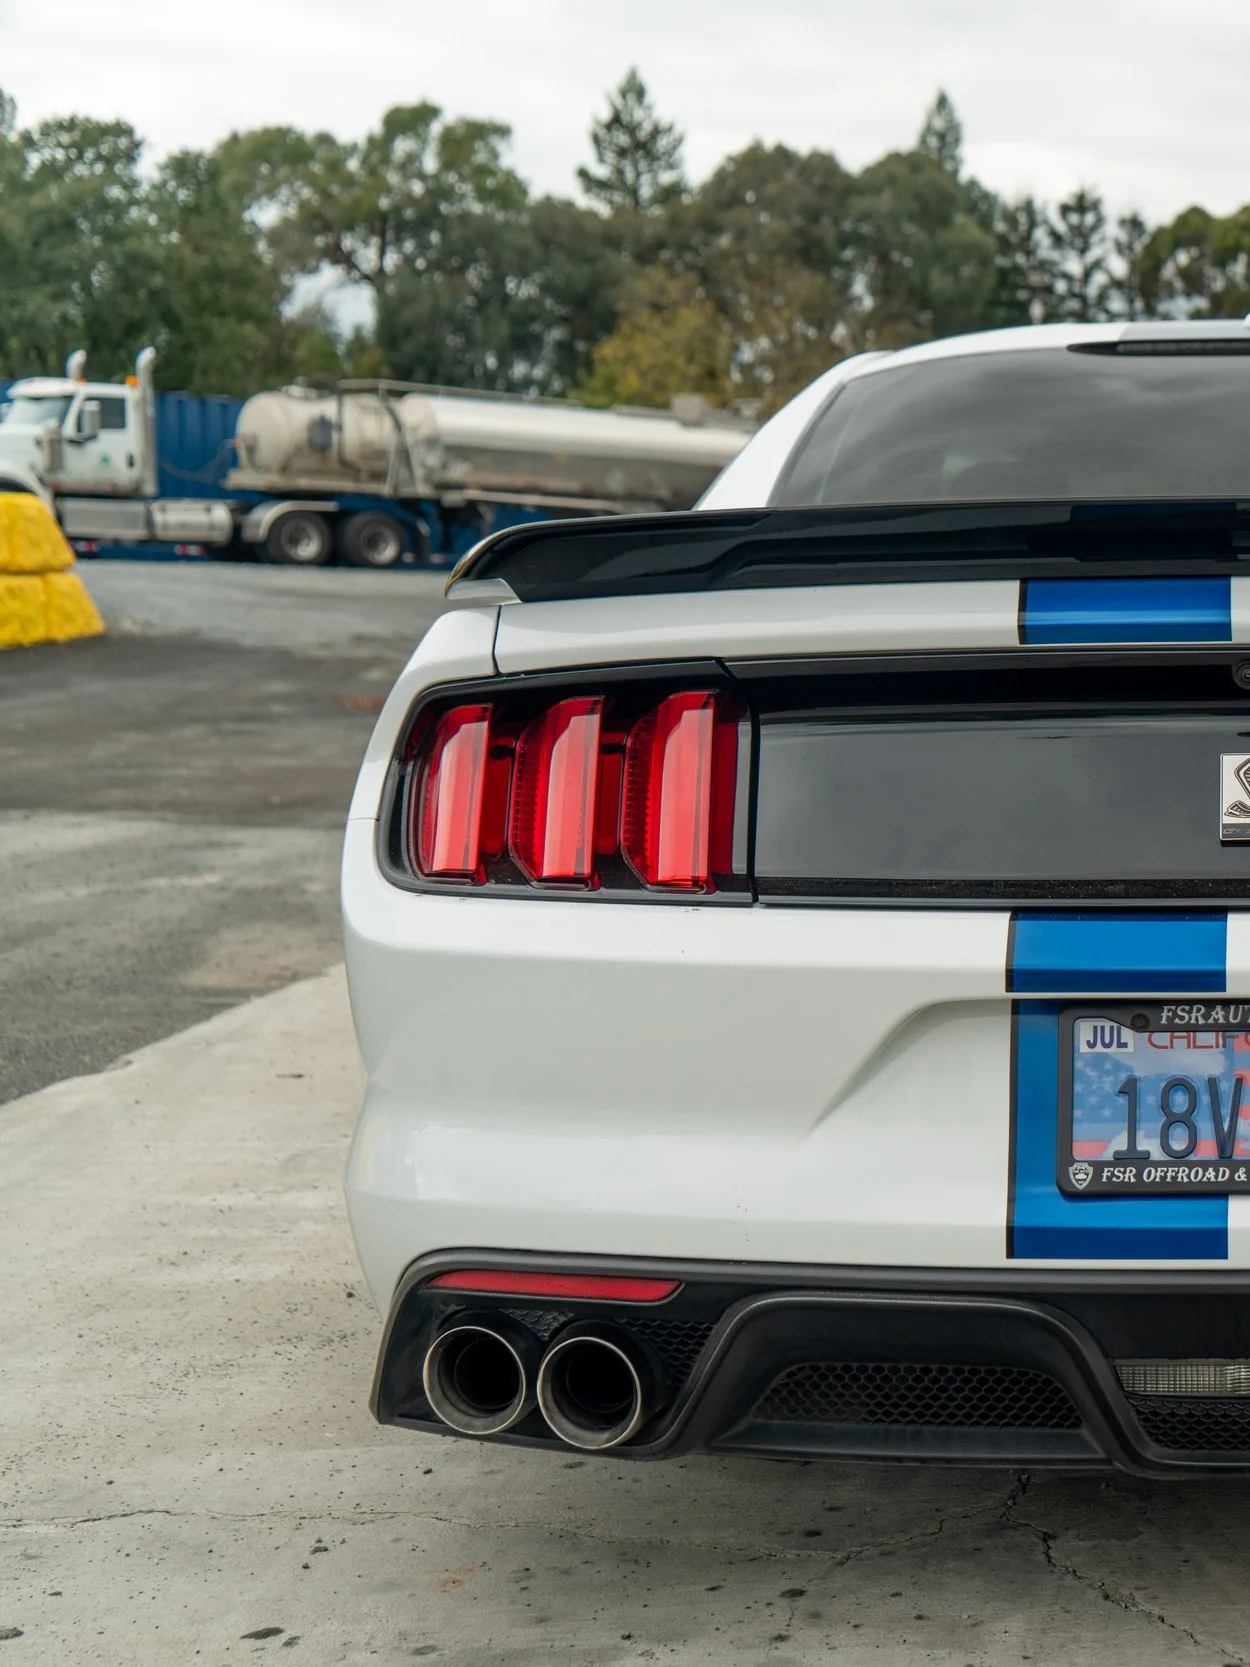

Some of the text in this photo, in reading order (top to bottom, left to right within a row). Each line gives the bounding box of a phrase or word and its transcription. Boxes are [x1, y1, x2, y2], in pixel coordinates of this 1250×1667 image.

[1086, 1025, 1128, 1049] JUL
[1101, 1166, 1137, 1183] FSR
[1143, 1166, 1230, 1183] OFFROAD
[1234, 1166, 1248, 1182] &
